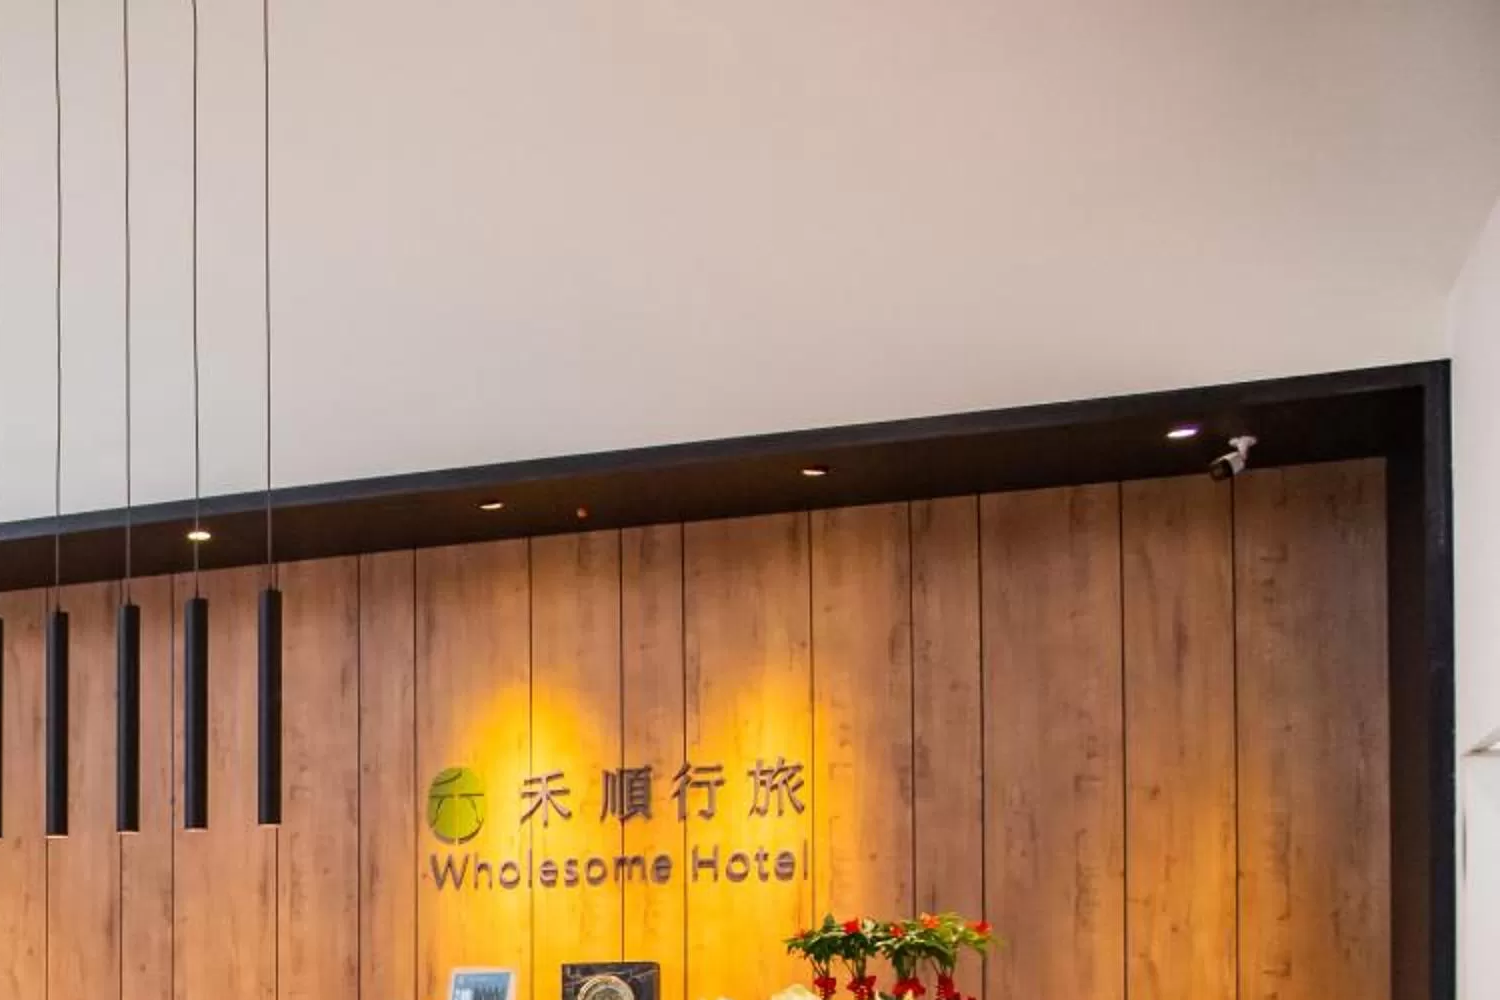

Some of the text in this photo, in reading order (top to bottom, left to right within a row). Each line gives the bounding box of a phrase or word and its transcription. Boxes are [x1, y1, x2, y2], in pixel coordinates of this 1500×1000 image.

[519, 758, 806, 827] 禾順行旅
[429, 840, 809, 890] Wholesome Hotel
